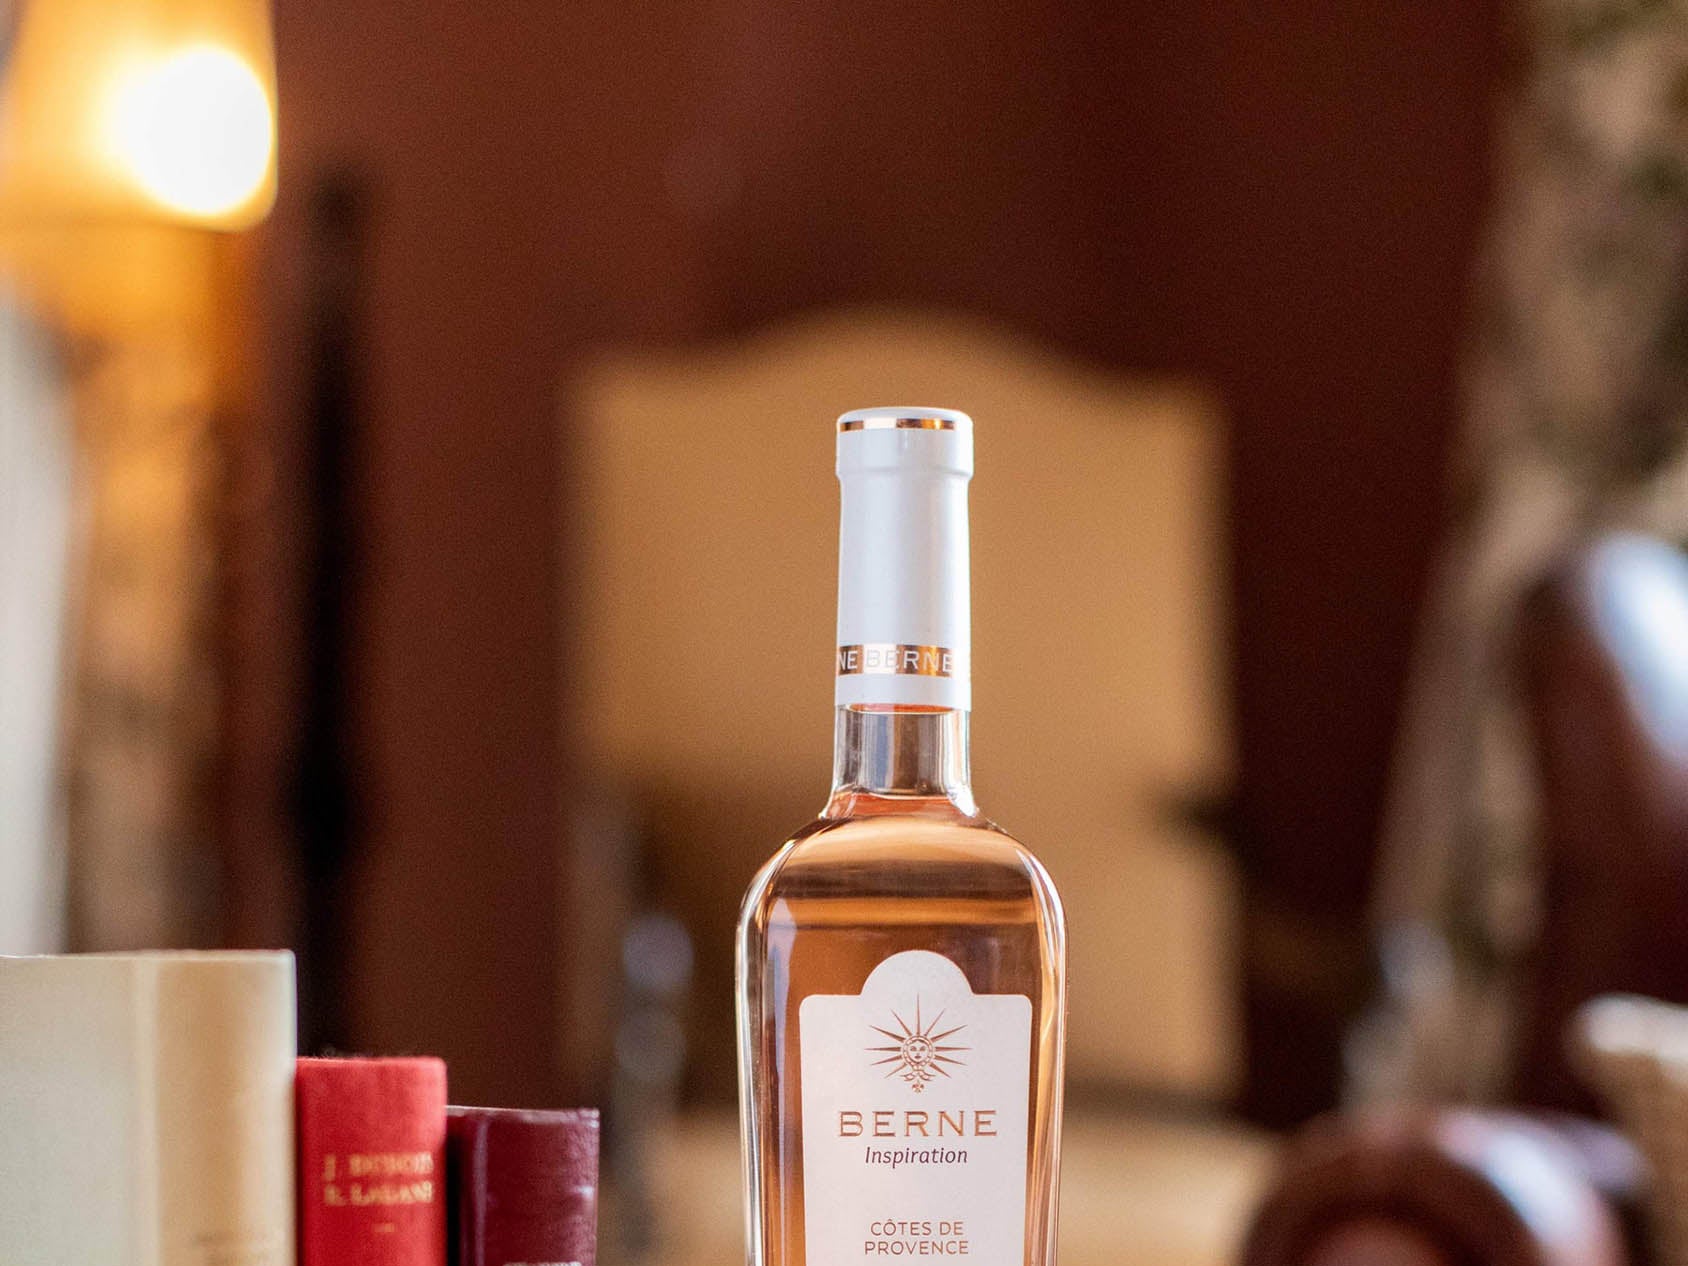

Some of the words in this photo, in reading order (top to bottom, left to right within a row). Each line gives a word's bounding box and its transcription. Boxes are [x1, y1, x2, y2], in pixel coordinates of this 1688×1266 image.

[839, 1110, 998, 1137] BERNE
[865, 1146, 968, 1169] Inspiration
[870, 1219, 932, 1236] CÔTES
[939, 1221, 964, 1236] DE
[864, 1240, 969, 1255] PROVENCE
